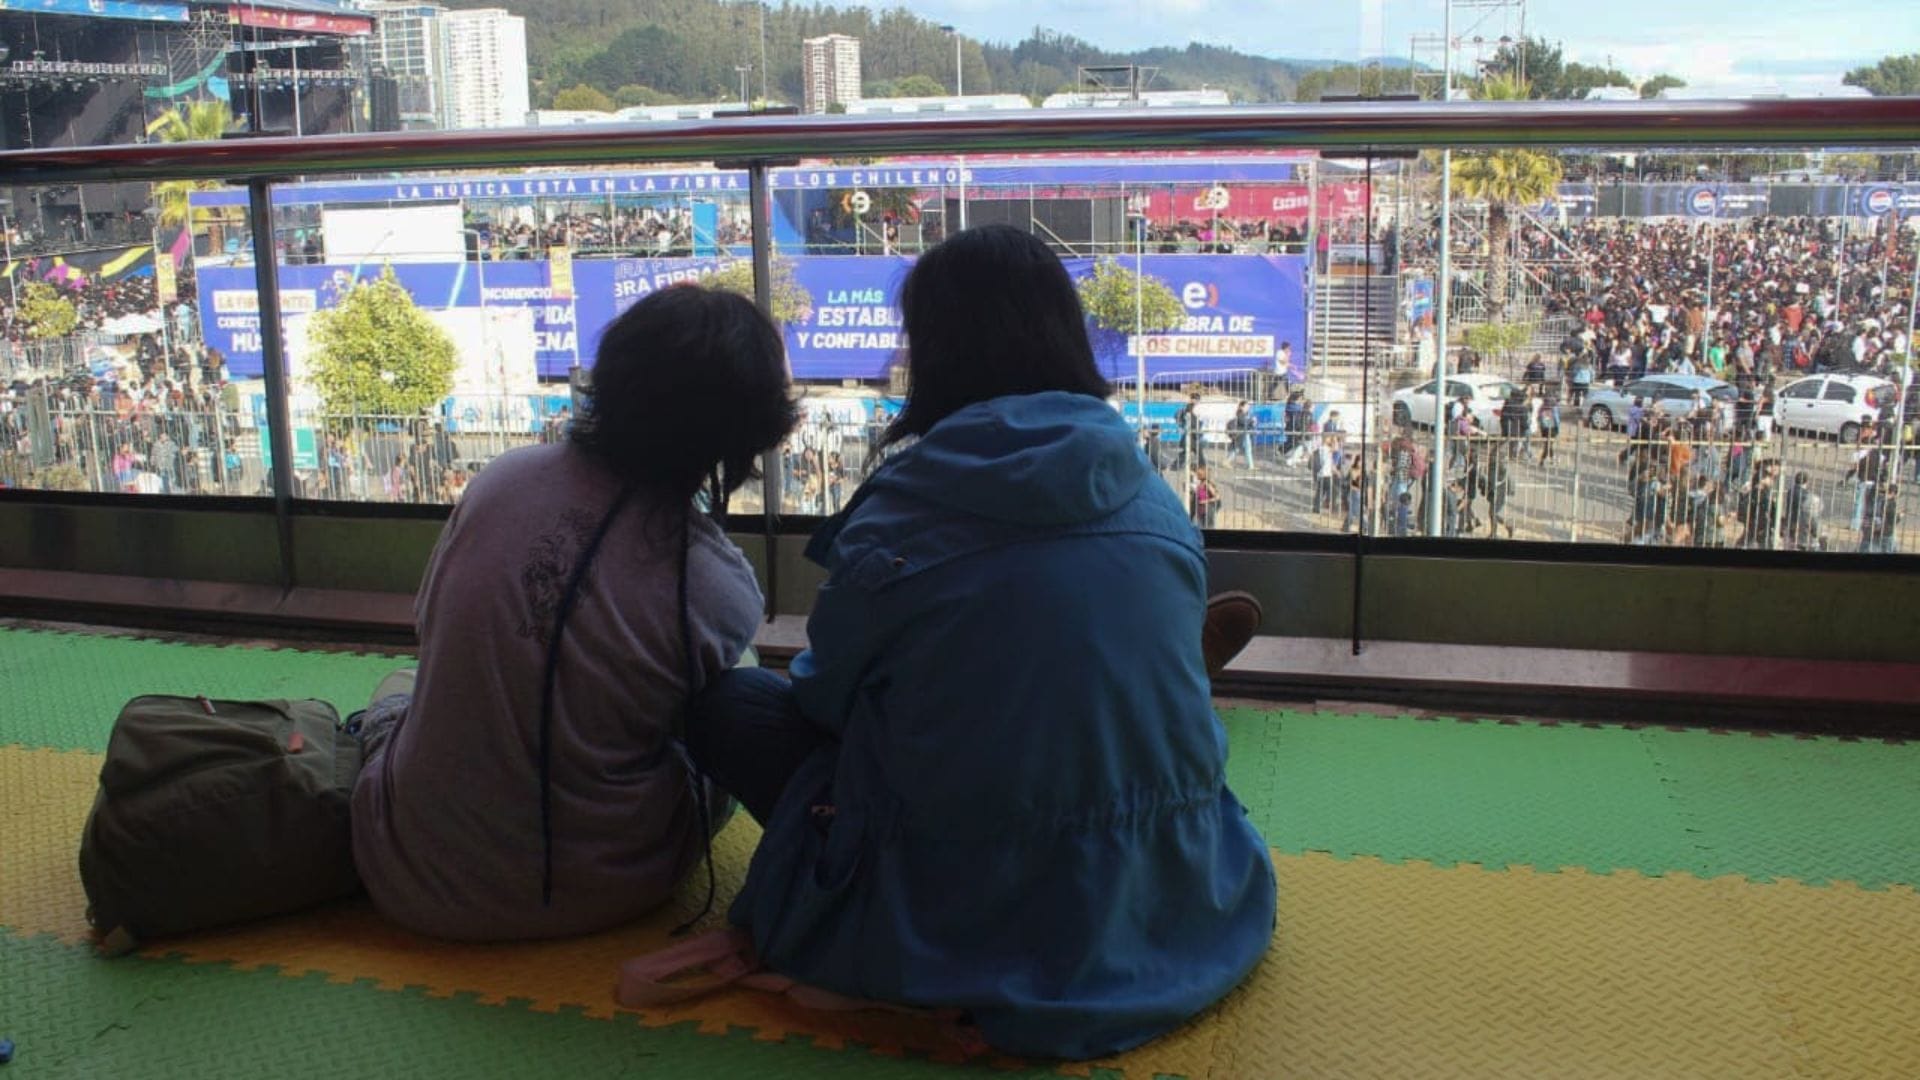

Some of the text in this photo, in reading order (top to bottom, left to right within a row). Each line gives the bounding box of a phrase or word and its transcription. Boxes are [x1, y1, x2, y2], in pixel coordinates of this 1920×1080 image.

[397, 186, 420, 199] LA
[630, 178, 656, 192] LA
[671, 175, 738, 190] FIBRA
[794, 172, 837, 187] LOS
[852, 169, 973, 186] CHILENOS
[827, 286, 884, 304] LA MÁS
[818, 306, 901, 327] ESTABL
[1228, 315, 1256, 333] DE
[797, 332, 909, 350] Y CONFIABL
[1175, 338, 1268, 354] CHILENOS
